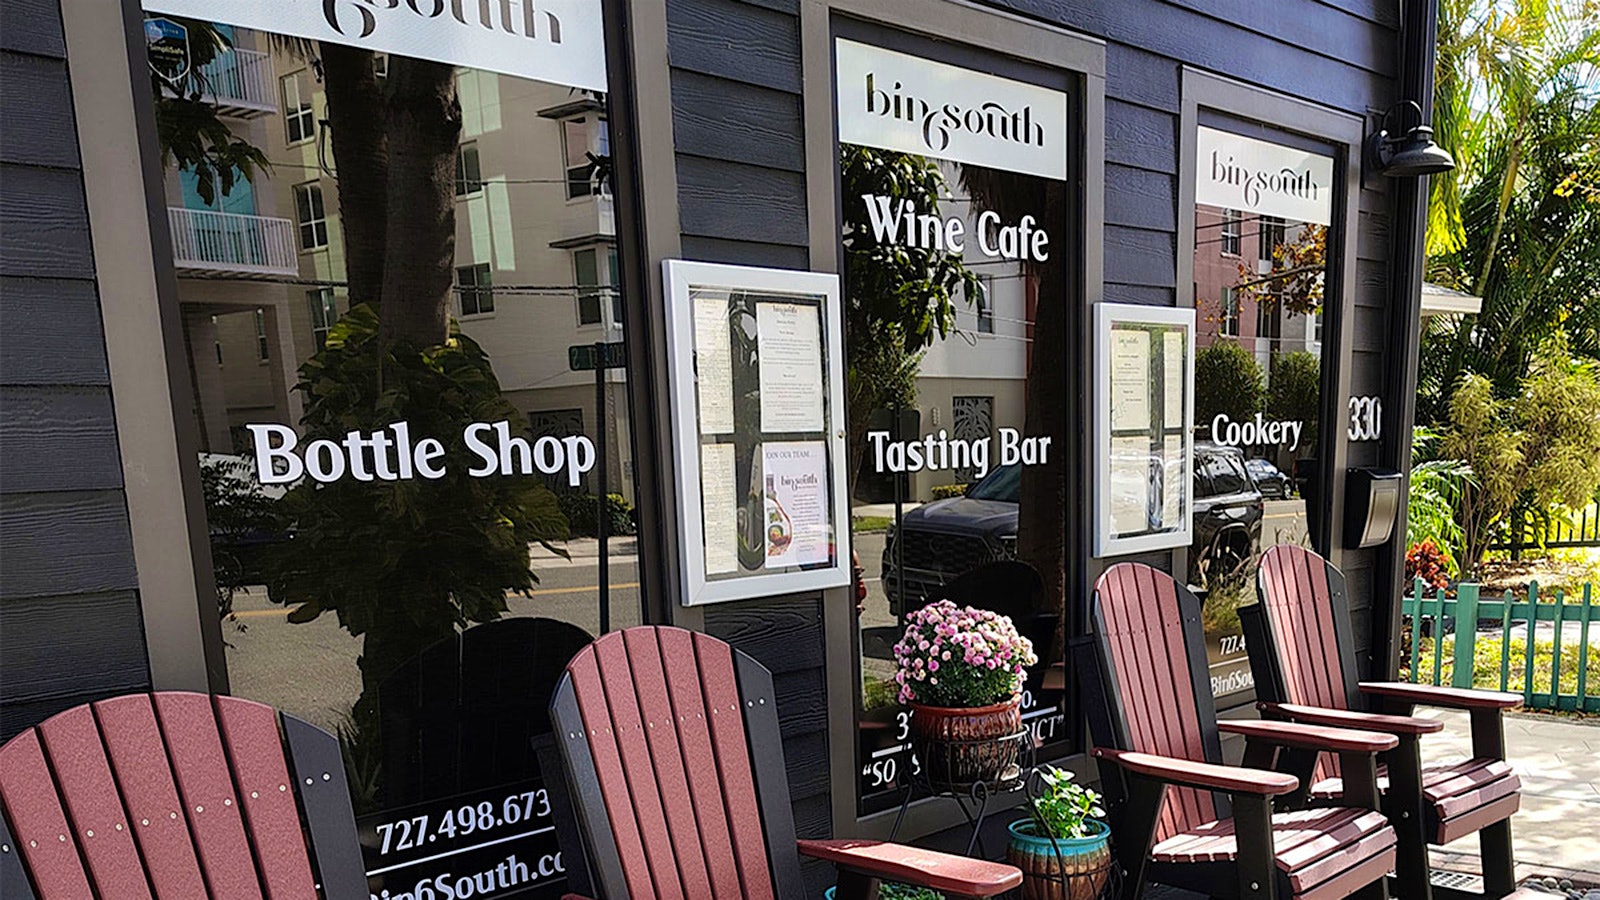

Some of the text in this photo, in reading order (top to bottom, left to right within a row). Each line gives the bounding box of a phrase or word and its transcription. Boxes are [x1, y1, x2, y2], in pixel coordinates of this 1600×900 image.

[861, 194, 1049, 262] Wine Cafe
[1212, 412, 1303, 451] Cookery
[1347, 396, 1382, 441] 330
[246, 420, 596, 487] Bottle Shop
[868, 428, 1052, 479] Tasting Bar
